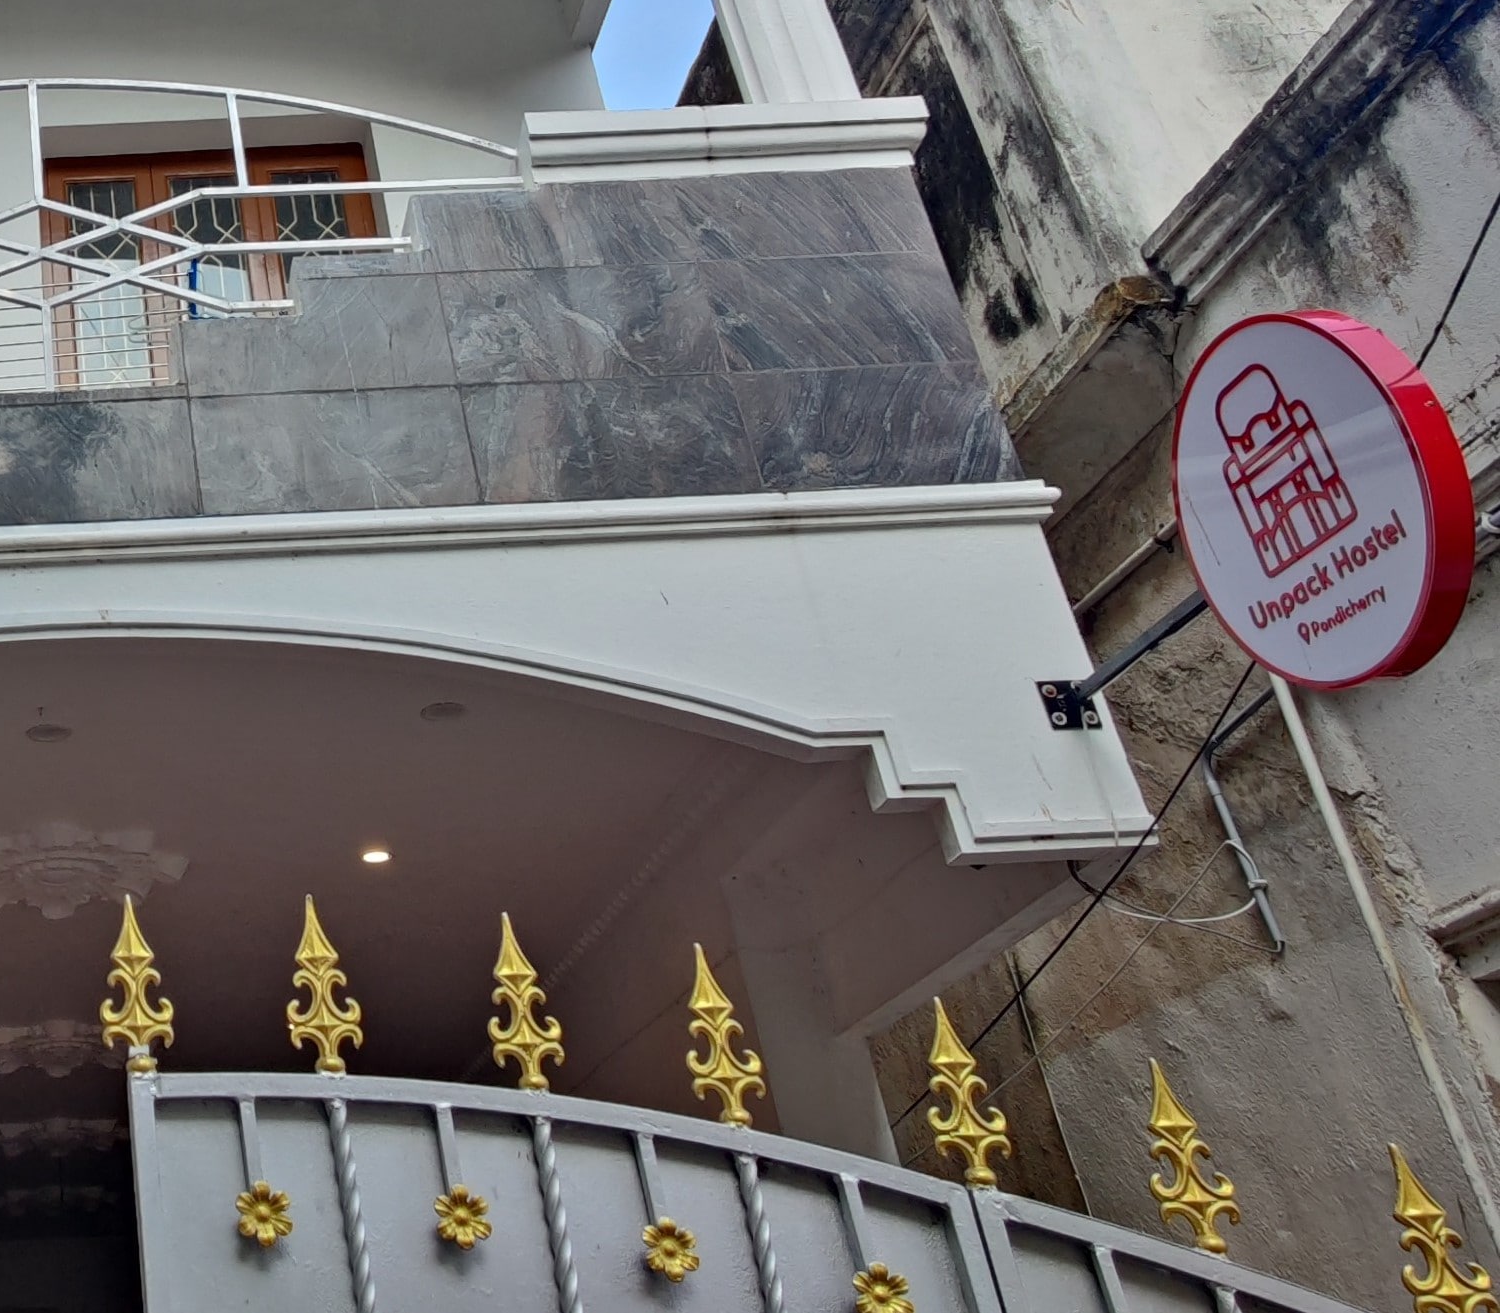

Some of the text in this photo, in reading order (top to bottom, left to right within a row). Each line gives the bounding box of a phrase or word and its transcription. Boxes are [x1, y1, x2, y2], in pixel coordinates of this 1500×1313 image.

[1248, 508, 1407, 629] Unpack Hostel
[1311, 585, 1386, 637] Pondicherry
